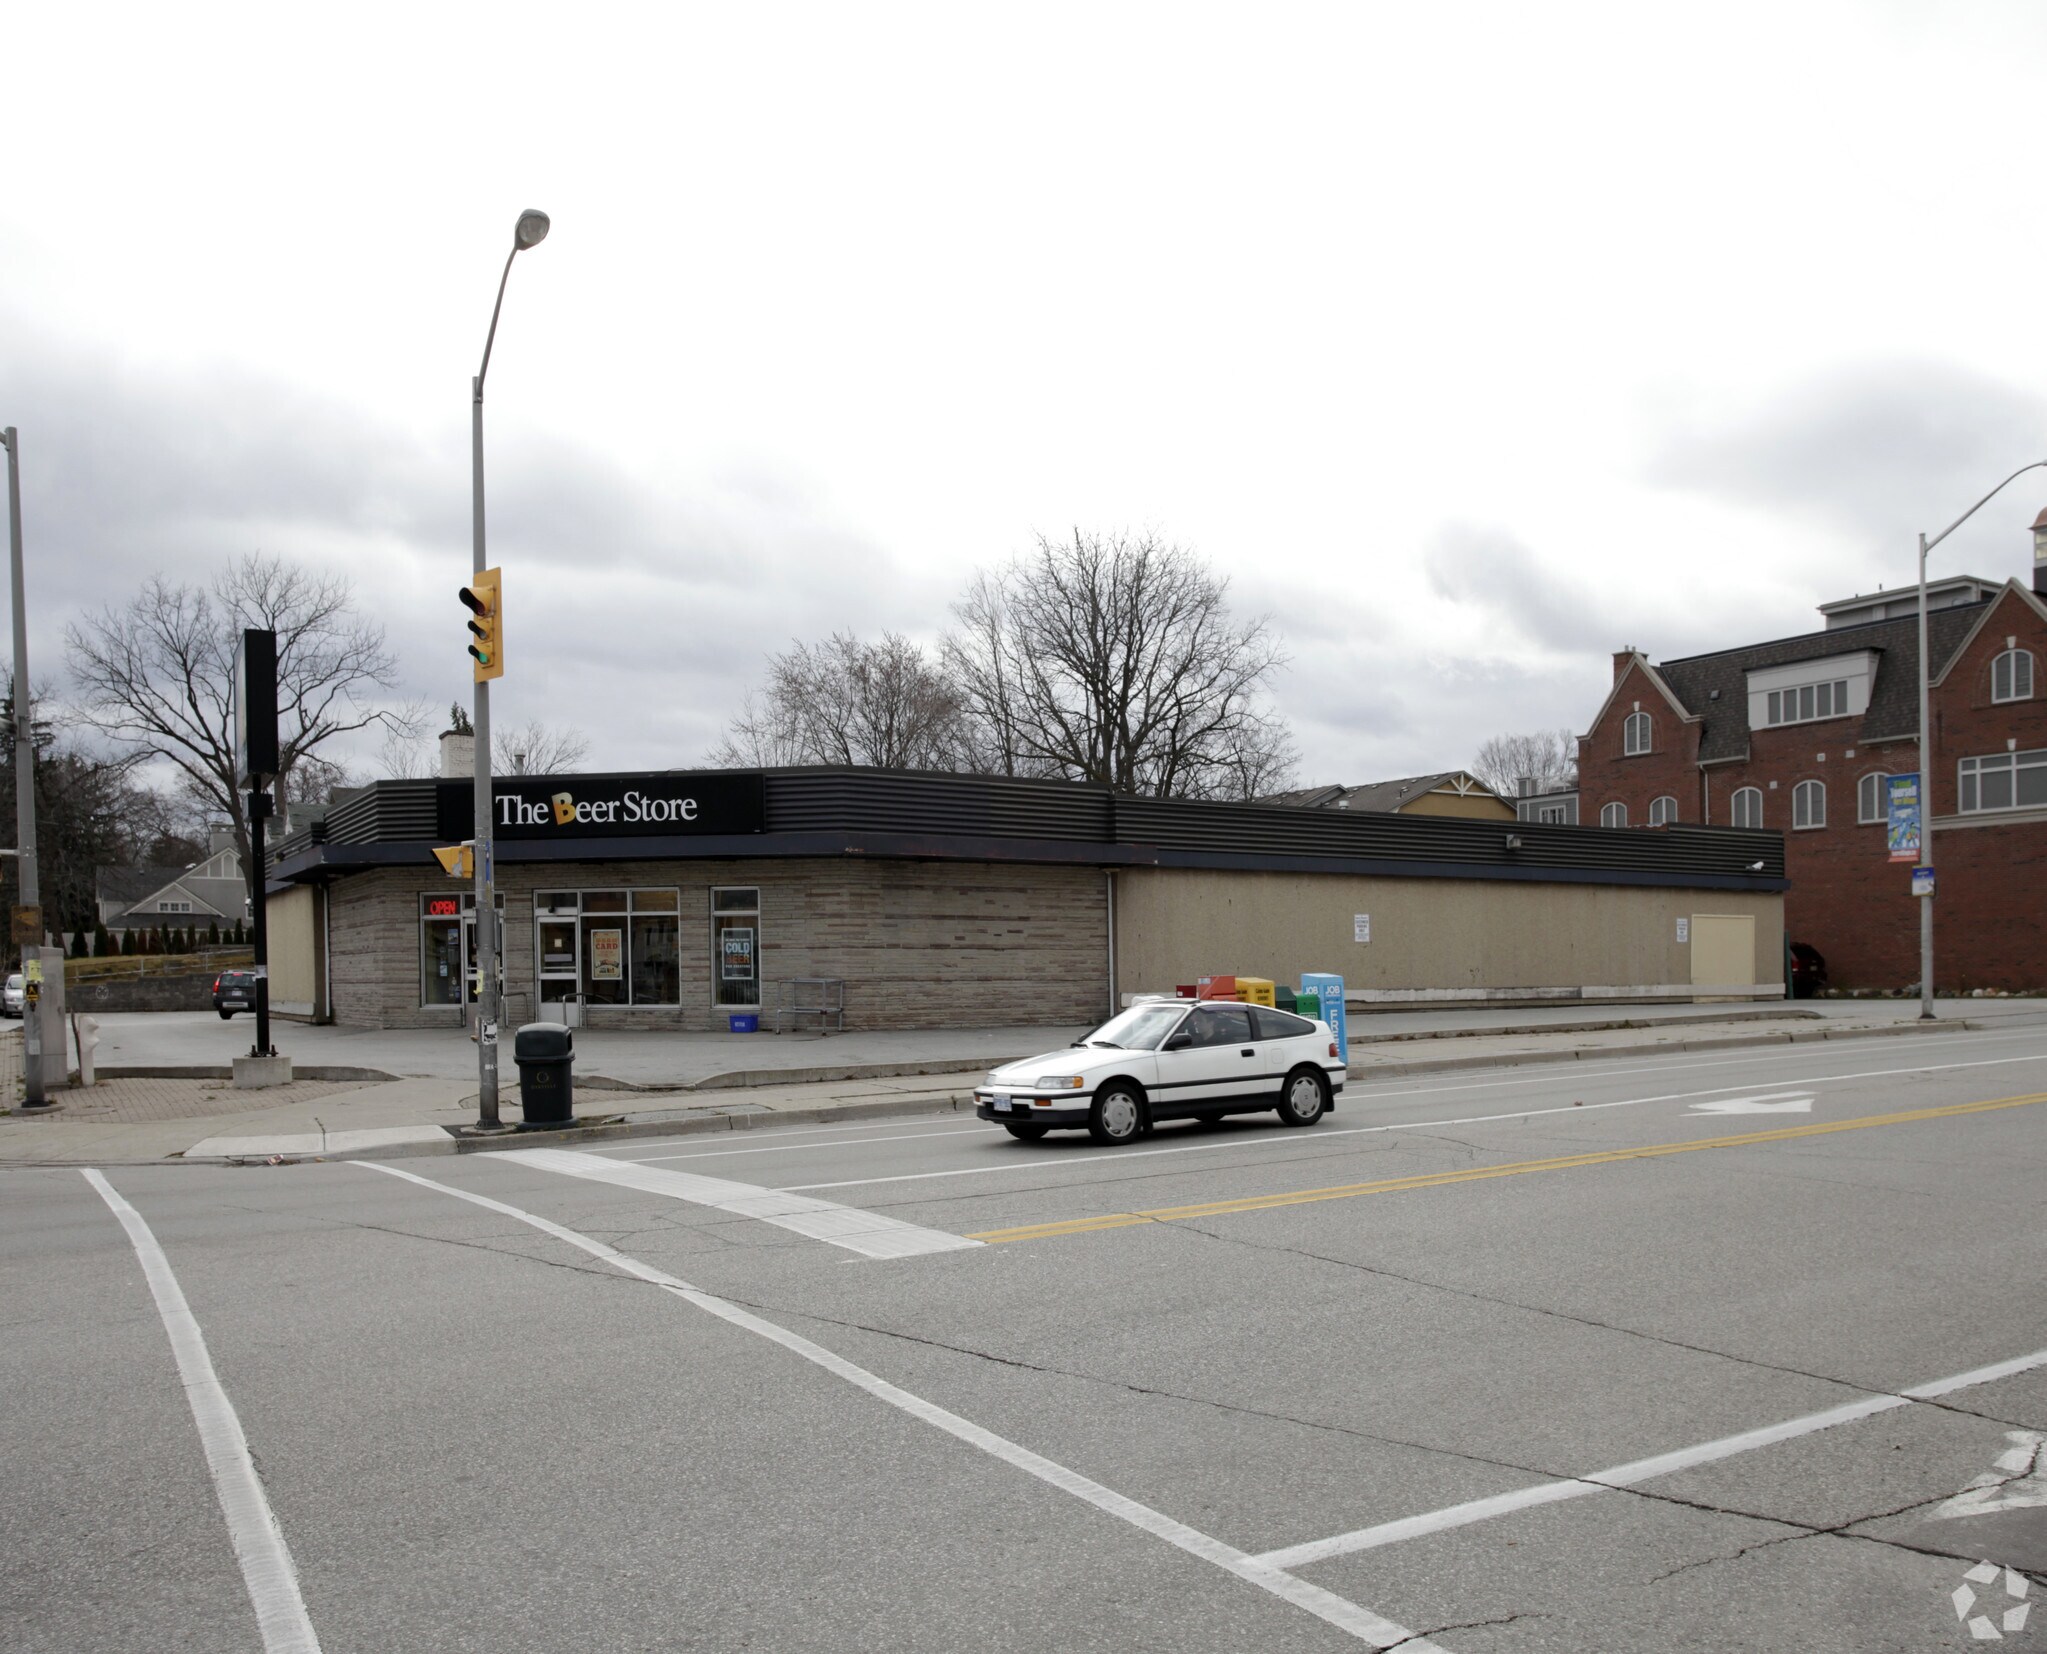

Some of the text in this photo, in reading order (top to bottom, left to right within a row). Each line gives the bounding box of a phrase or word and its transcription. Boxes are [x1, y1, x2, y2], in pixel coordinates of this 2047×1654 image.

[495, 791, 697, 826] The Beer Store
[430, 901, 456, 915] OPEN
[725, 942, 750, 954] COLD
[725, 954, 750, 964] BEER
[1305, 986, 1319, 995] JOB
[1325, 985, 1340, 994] JOB
